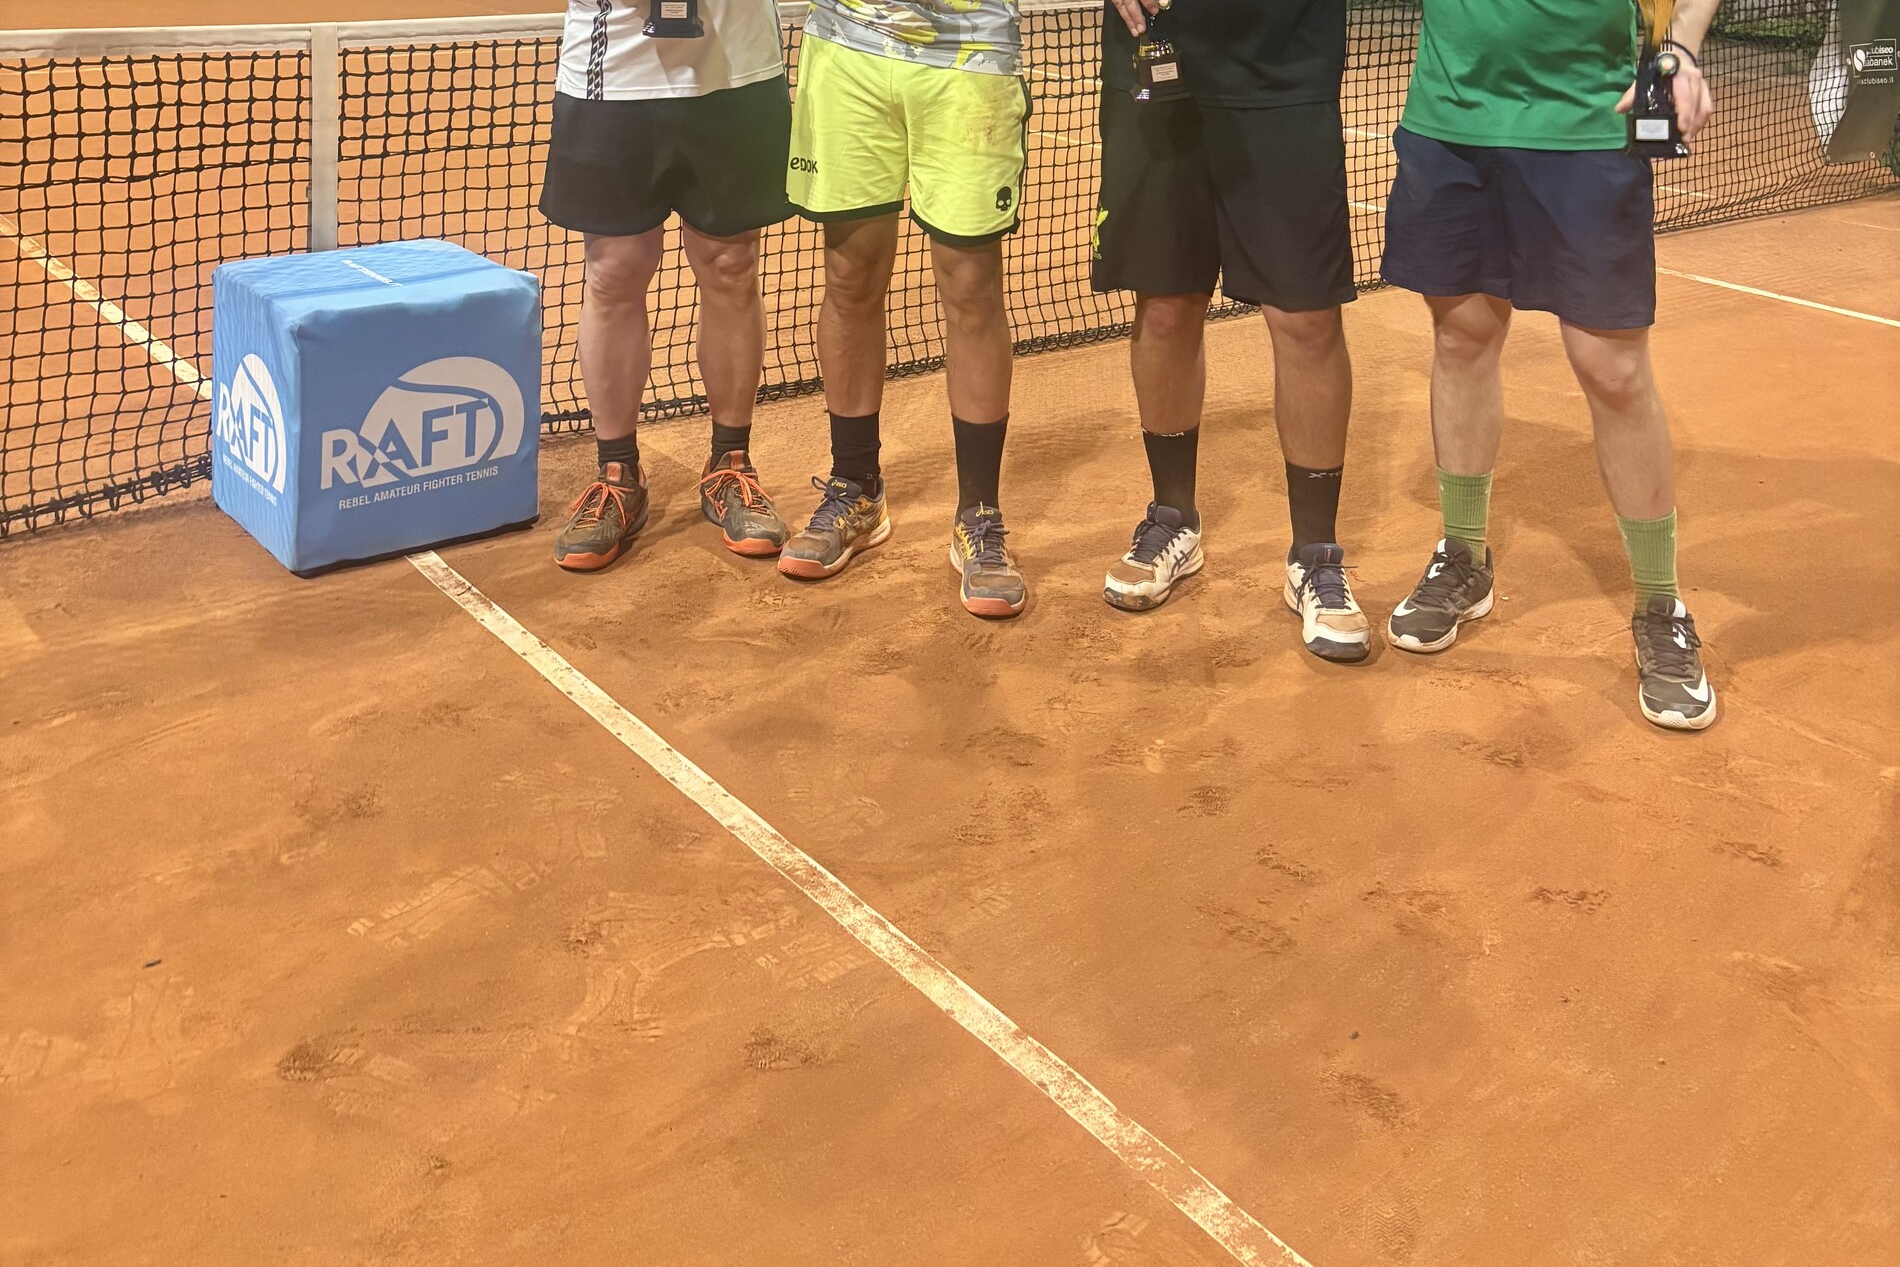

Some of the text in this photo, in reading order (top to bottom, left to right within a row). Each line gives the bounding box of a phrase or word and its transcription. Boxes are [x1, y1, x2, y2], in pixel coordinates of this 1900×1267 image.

[320, 397, 489, 490] RAFT
[338, 465, 499, 511] REBEL AMATEUR FIGHTER TENNIS
